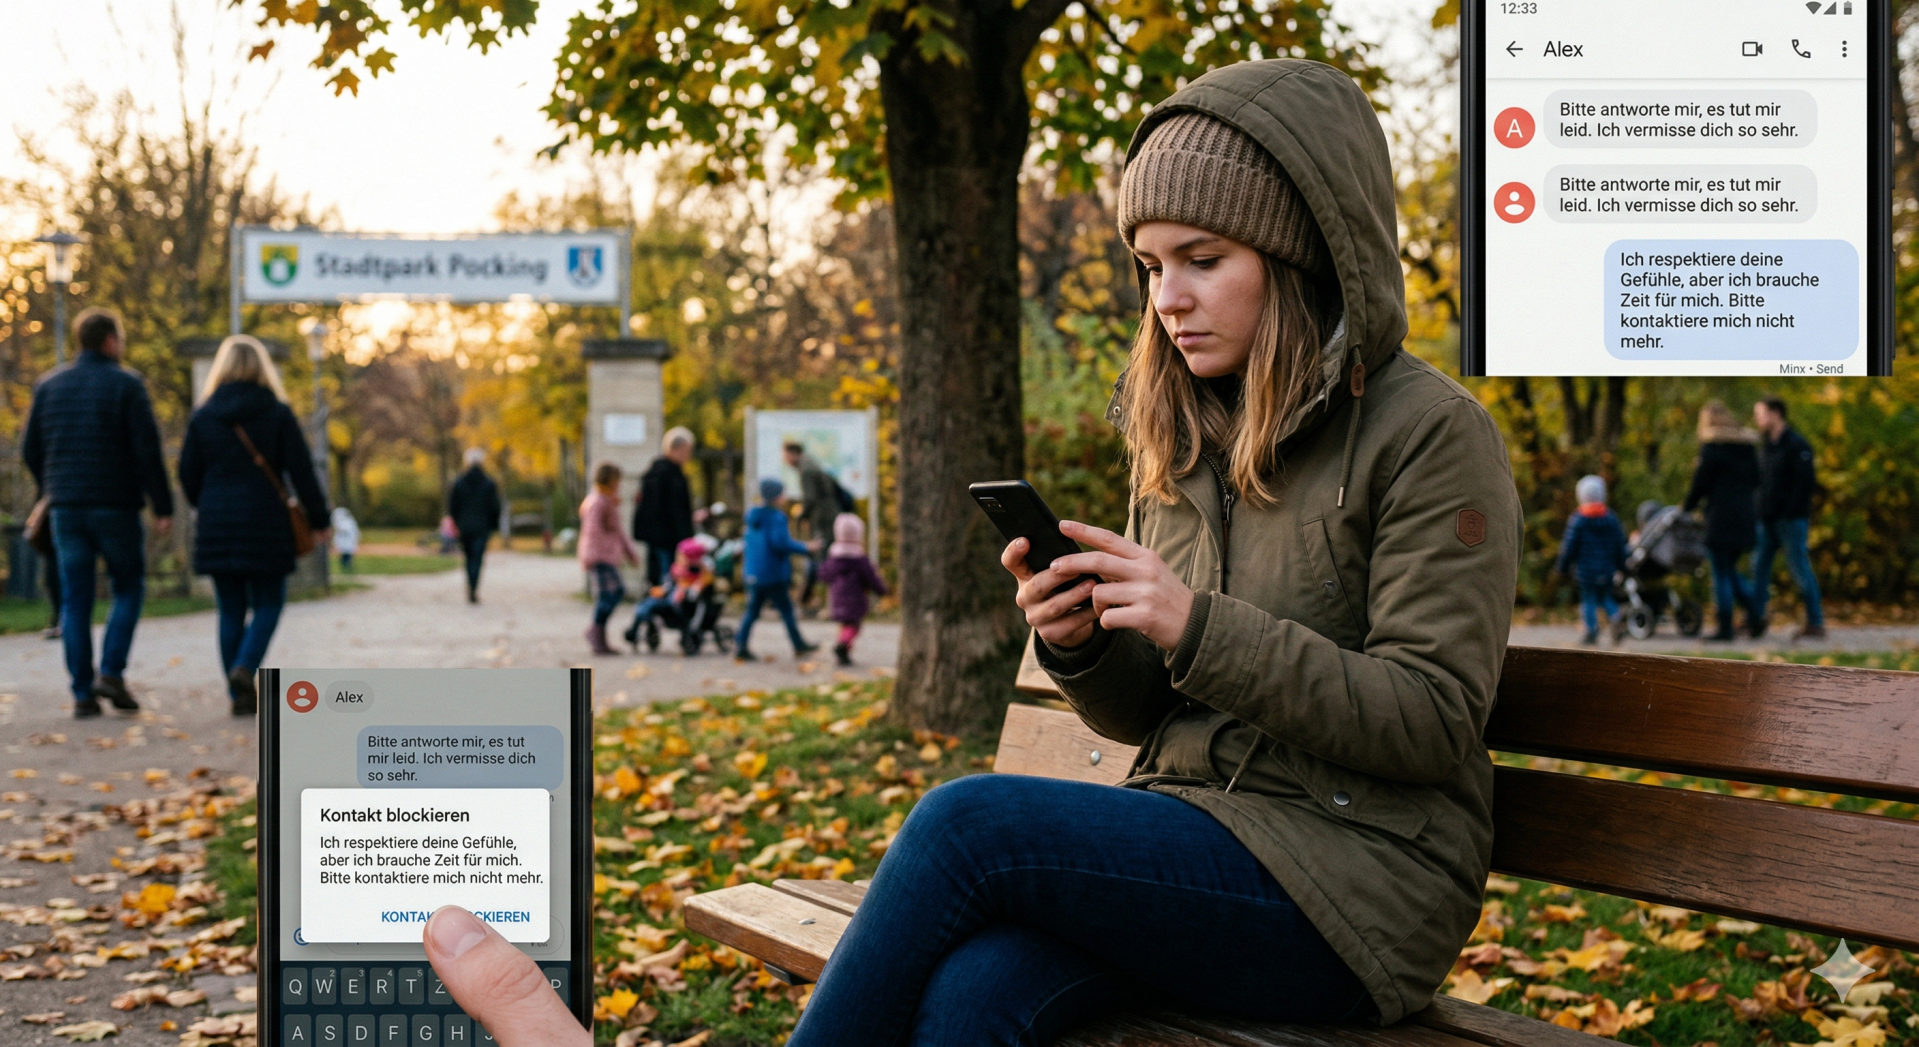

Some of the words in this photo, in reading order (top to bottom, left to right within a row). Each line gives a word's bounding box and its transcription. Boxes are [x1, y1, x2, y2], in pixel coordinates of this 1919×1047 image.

[1500, 2, 1538, 15] 12:33
[1542, 40, 1584, 58] Alex
[1560, 101, 1596, 117] Bitte
[1600, 102, 1671, 117] antworte
[1674, 101, 1703, 119] mir,
[1706, 104, 1726, 117] es
[1728, 102, 1751, 117] tut
[1755, 101, 1782, 117] mir
[1506, 118, 1524, 139] A
[1560, 121, 1592, 138] leid.
[1597, 121, 1621, 138] Ich
[1624, 122, 1697, 138] vermisse
[1700, 121, 1734, 138] dich
[1737, 125, 1758, 138] so
[1761, 121, 1799, 138] sehr.
[1560, 176, 1596, 192] Bitte
[1600, 178, 1671, 192] antworte
[1674, 176, 1703, 194] mir,
[1706, 180, 1726, 192] es
[1728, 177, 1751, 192] tut
[1755, 176, 1782, 192] mir
[1559, 197, 1592, 213] leid.
[1597, 197, 1621, 213] Ich
[1624, 197, 1697, 213] vermisse
[1699, 196, 1734, 213] dich
[1737, 200, 1758, 213] so
[1761, 197, 1799, 213] sehr.
[315, 251, 440, 283] Stadtpark
[1620, 251, 1644, 267] Ich
[1648, 251, 1736, 270] respektiere
[1739, 251, 1784, 267] deine
[1620, 271, 1685, 289] Gefühle,
[1688, 271, 1725, 288] aber
[1728, 271, 1752, 288] ich
[1756, 271, 1820, 288] brauche
[1620, 292, 1651, 308] Zeit
[1654, 291, 1678, 308] für
[1680, 292, 1724, 308] mich.
[1728, 292, 1765, 308] Bitte
[1620, 312, 1709, 328] kontaktiere
[1713, 312, 1752, 328] mich
[1756, 312, 1795, 328] nicht
[1620, 333, 1664, 349] mehr.
[1779, 363, 1806, 374] Minx
[1816, 362, 1844, 375] Send
[335, 690, 364, 704] Alex
[368, 735, 398, 748] Bitte
[400, 736, 459, 748] antworte
[461, 735, 486, 750] mir,
[488, 738, 504, 748] es
[507, 736, 525, 748] tut
[367, 752, 390, 764] mir
[392, 751, 419, 765] leid.
[423, 751, 443, 765] Ich
[445, 752, 505, 765] vermisse
[508, 751, 536, 765] dich
[367, 771, 384, 782] so
[387, 768, 418, 782] sehr.
[320, 807, 383, 823] Kontakt
[386, 807, 470, 823] blockieren
[320, 835, 340, 849] Ich
[343, 835, 419, 852] respektiere
[421, 835, 459, 849] deine
[461, 835, 517, 851] Gefühle,
[319, 853, 351, 867] aber
[353, 853, 374, 867] ich
[376, 853, 431, 867] brauche
[434, 853, 460, 867] Zeit
[463, 852, 483, 867] für
[485, 853, 523, 867] mich.
[320, 871, 351, 885] Bitte
[354, 870, 430, 885] kontaktiere
[432, 870, 466, 885] mich
[469, 870, 503, 885] nicht
[506, 870, 544, 885] mehr.
[381, 910, 432, 923] KONTAK
[468, 910, 531, 923] CKIEREN
[329, 969, 335, 978] 2
[358, 969, 364, 978] 3
[386, 969, 393, 978] 4
[416, 969, 423, 978] 5
[288, 978, 303, 996] Q
[315, 978, 333, 994] W
[348, 978, 359, 994] E
[376, 978, 388, 994] R
[405, 978, 417, 994] T
[434, 979, 446, 994] Z
[291, 1025, 305, 1041] A
[323, 1025, 337, 1042] S
[355, 1025, 369, 1041] D
[388, 1025, 400, 1041] F
[419, 1025, 433, 1042] G
[451, 1025, 464, 1041] H
